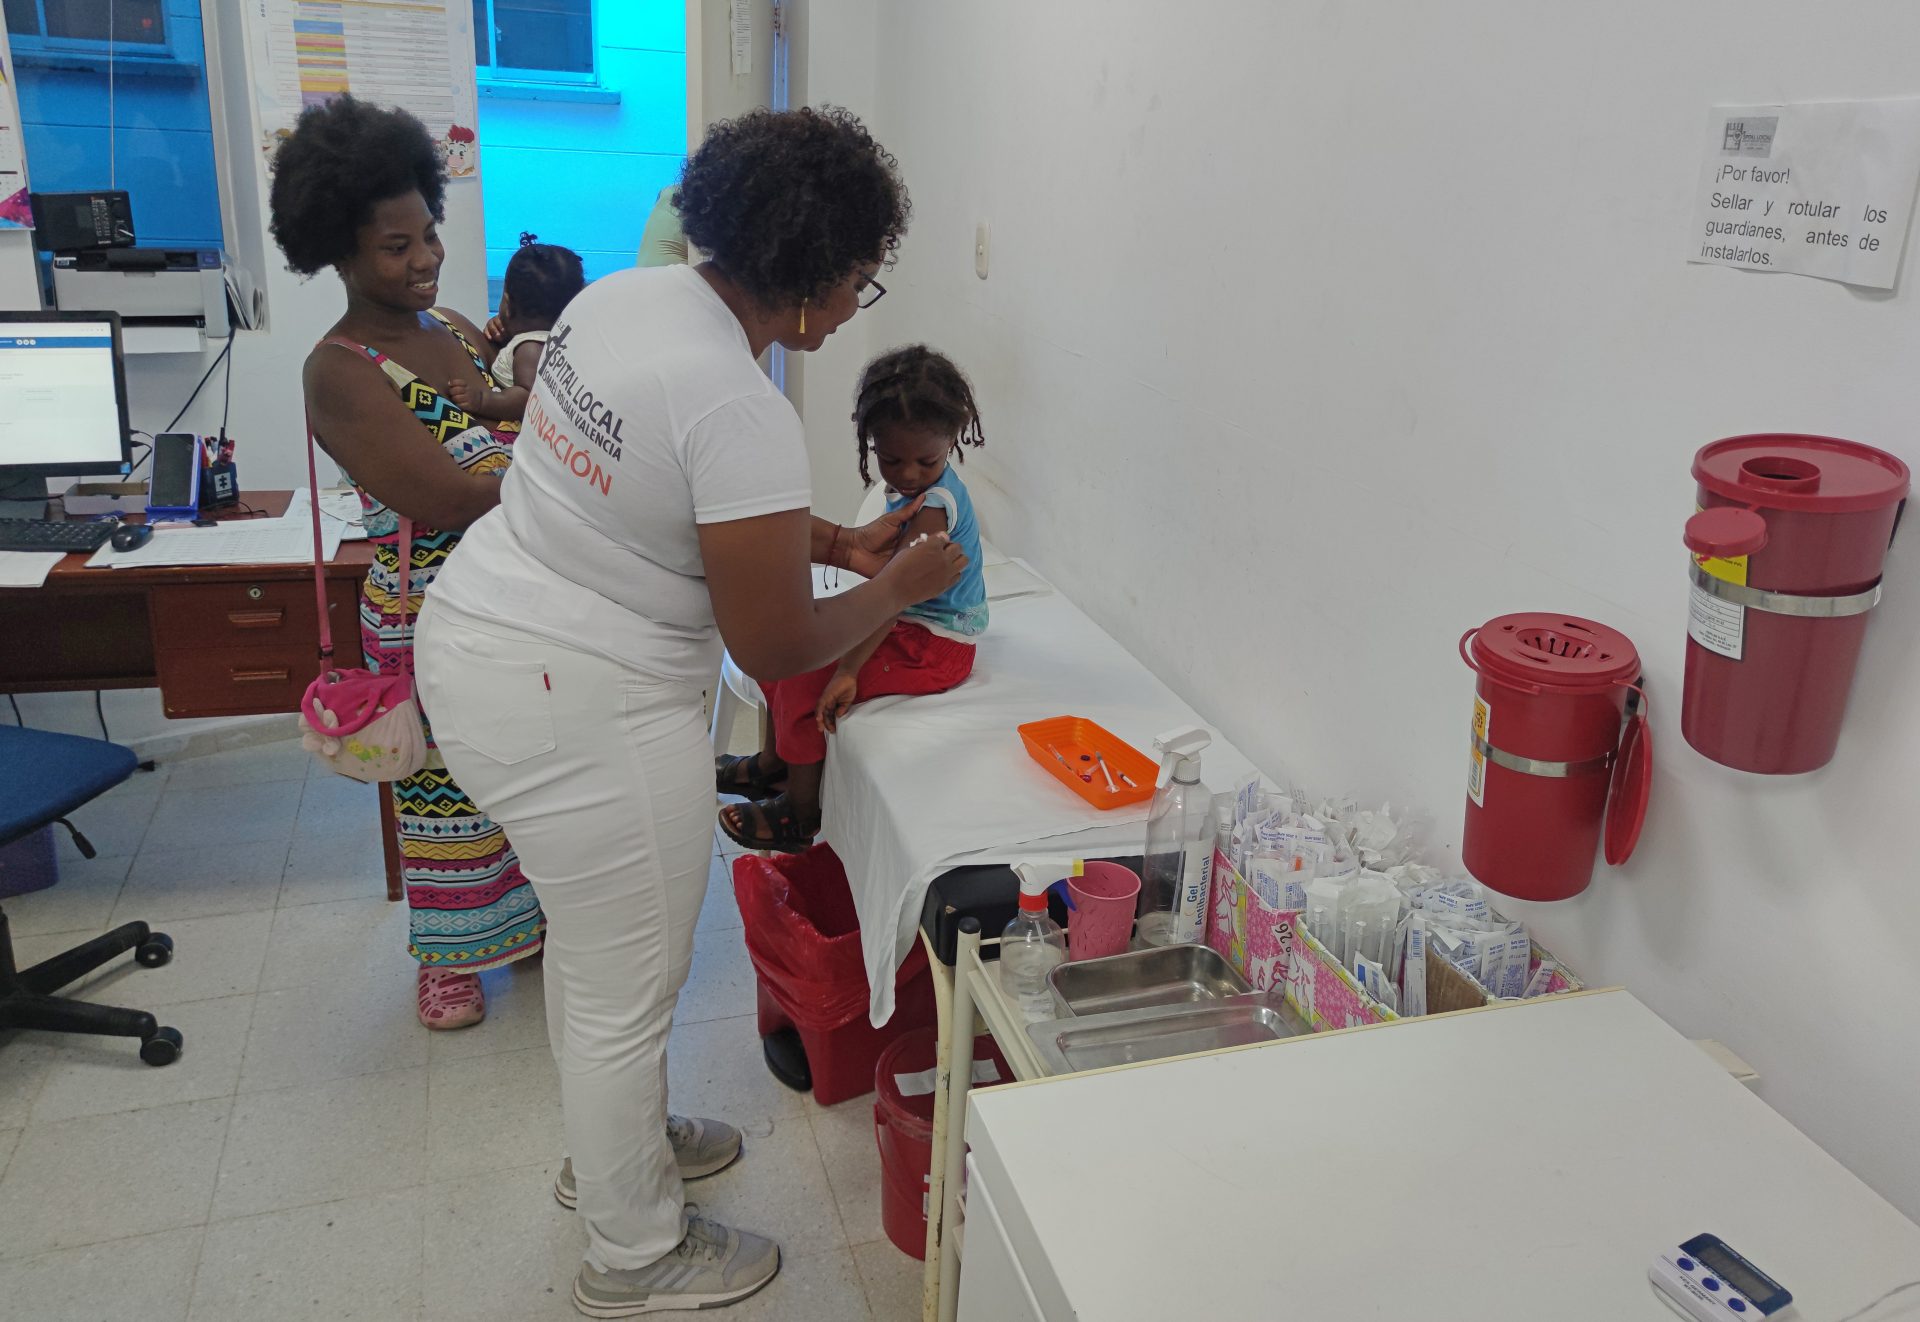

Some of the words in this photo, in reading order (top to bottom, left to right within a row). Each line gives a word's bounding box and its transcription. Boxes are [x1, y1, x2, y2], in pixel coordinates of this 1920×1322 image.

[1715, 164, 1747, 184] ¡Por
[1751, 166, 1790, 184] favor!
[1711, 192, 1753, 211] Sellar
[1764, 200, 1774, 216] y
[1788, 201, 1840, 219] rotular
[1863, 204, 1887, 224] los
[1705, 220, 1786, 243] guardianes,
[1806, 229, 1849, 247] antes
[1858, 233, 1880, 252] de
[1701, 242, 1774, 266] instalarlos.
[572, 384, 624, 444] LOCAL
[574, 415, 622, 462] VALENCIA
[1187, 884, 1198, 903] Gel
[1195, 855, 1210, 927] Antibacterial
[1275, 923, 1293, 944] 26
